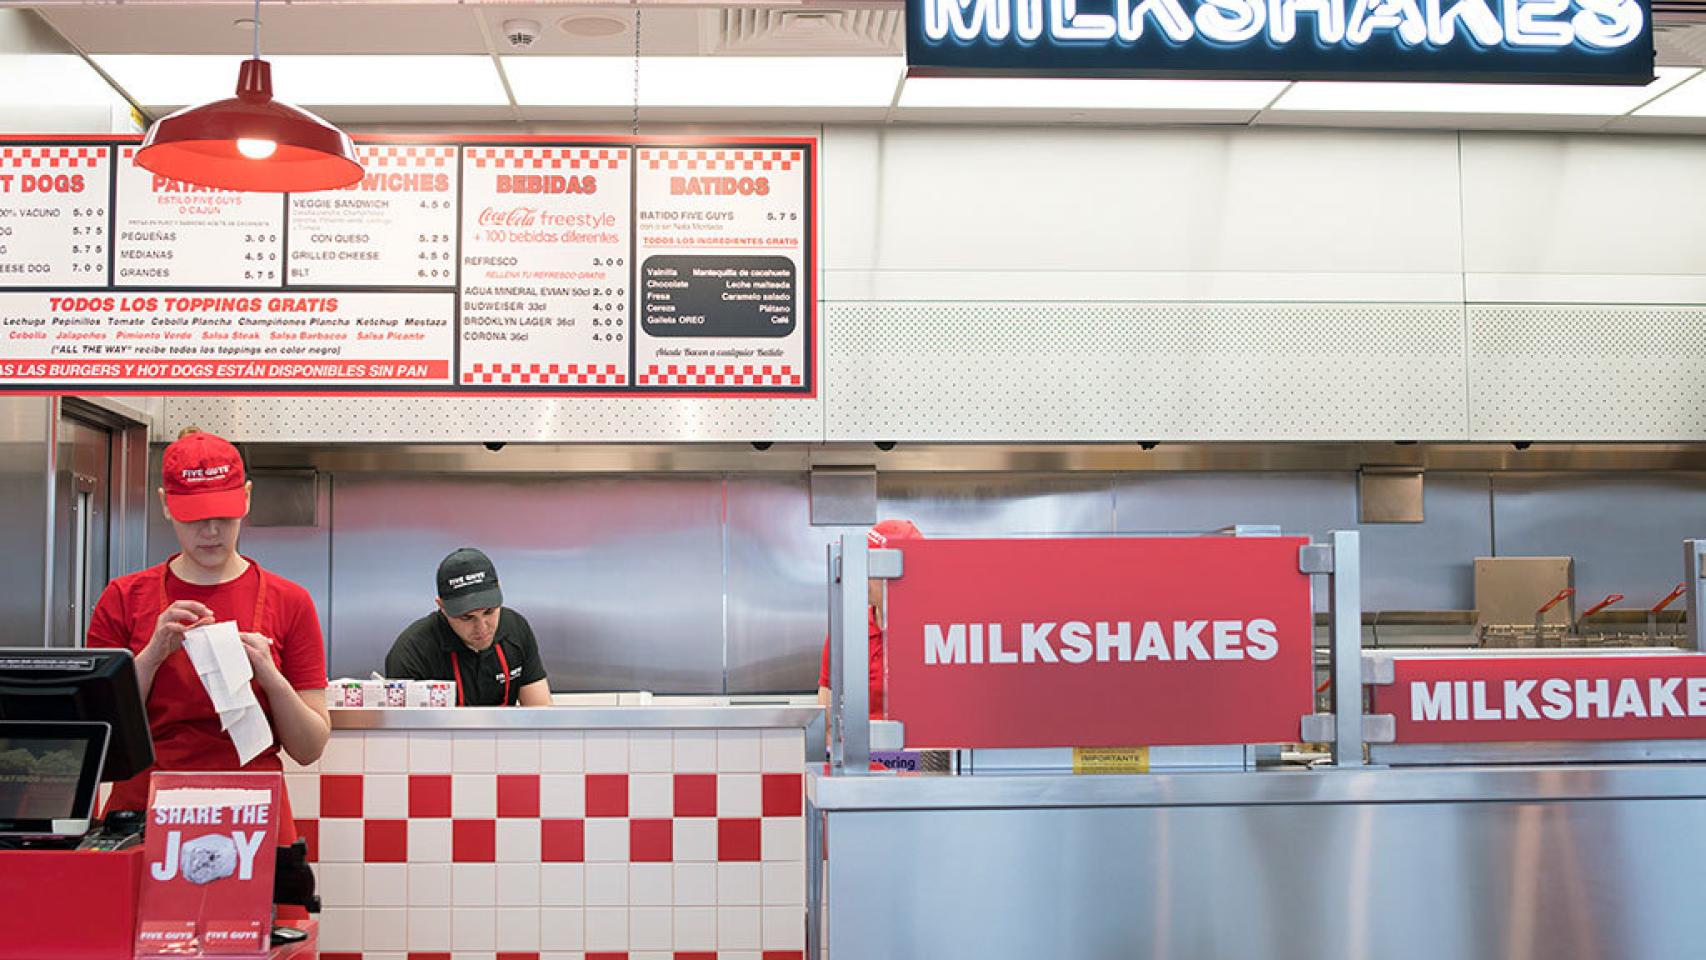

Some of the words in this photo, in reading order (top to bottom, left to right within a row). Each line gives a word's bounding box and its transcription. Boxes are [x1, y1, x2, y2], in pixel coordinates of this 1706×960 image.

[21, 174, 85, 193] DOGS
[342, 172, 449, 192] WICHES
[496, 174, 597, 194] BEBIDAS
[670, 176, 770, 196] BATIDOS
[292, 200, 331, 209] VEGGIE
[334, 200, 389, 209] SANDWICH
[20, 208, 61, 218] VACUNO
[640, 212, 678, 220] BATIDO
[681, 212, 703, 220] FIVE
[706, 212, 734, 220] GUYS
[540, 210, 616, 229] freestyle
[121, 230, 176, 241] PEQUEÑAS
[311, 235, 332, 243] CON
[334, 235, 370, 243] QUESO
[485, 230, 506, 242] 100
[509, 230, 558, 243] bebidas
[561, 230, 619, 244] diferentes
[643, 237, 674, 245] TODOS
[677, 237, 694, 245] LOS
[698, 237, 763, 245] INGREDIENTES
[766, 237, 798, 245] GRATIS
[120, 250, 174, 259] MEDIANAS
[292, 252, 335, 260] GRILLED
[338, 252, 380, 260] CHEESE
[464, 256, 518, 266] REFRESCO
[28, 264, 51, 273] DOG
[120, 268, 170, 277] GRANDES
[291, 268, 310, 277] BLT
[647, 268, 678, 276] Vainilla
[692, 268, 737, 278] Mantequilla
[751, 268, 791, 277] cacahuete
[647, 280, 688, 288] Chocolate
[726, 281, 751, 289] Leche
[753, 281, 791, 289] malteada
[464, 287, 492, 296] AGUA
[494, 287, 537, 296] MINERAL
[540, 287, 569, 296] EVIAN
[647, 292, 670, 300] Fresa
[722, 293, 761, 301] Caramelo
[763, 293, 790, 301] salado
[50, 298, 115, 312] TODOS
[120, 298, 158, 312] LOS
[165, 298, 262, 312] TOPPINGS
[268, 298, 338, 312] GRATIS
[464, 302, 524, 311] BUDWEISER
[647, 304, 675, 312] Cereza
[3, 318, 46, 326] Lechuga
[52, 318, 101, 326] Pepinillos
[108, 318, 145, 326] Tomate
[151, 318, 189, 326] Cebolla
[192, 318, 232, 326] Plancha
[238, 318, 306, 326] Champiñones
[310, 318, 350, 326] Plancha
[356, 318, 399, 326] Ketchup
[404, 318, 447, 326] Mostaza
[464, 317, 517, 326] BROOKLYN
[520, 317, 552, 326] LAGER
[647, 316, 676, 324] Galleta
[678, 316, 704, 324] OREO
[10, 332, 47, 340] Cebolla
[56, 332, 107, 340] Jalapeños
[116, 332, 161, 340] Pimiento
[164, 332, 192, 340] Verde
[202, 332, 229, 340] Salsa
[232, 332, 260, 340] Steak
[270, 332, 297, 340] Salsa
[300, 332, 347, 340] Barbacoa
[357, 332, 384, 340] Salsa
[387, 332, 425, 340] Picante
[464, 332, 507, 341] CORONA
[82, 345, 101, 355] THE
[134, 345, 166, 355] recibe
[170, 345, 197, 355] todos
[200, 345, 215, 355] los
[218, 345, 261, 355] toppings
[265, 345, 277, 355] en
[280, 345, 306, 355] color
[308, 345, 341, 355] negro)
[16, 364, 46, 376] LAS
[49, 364, 120, 376] BURGERS
[124, 364, 135, 376] Y
[137, 364, 169, 376] HOT
[171, 364, 213, 376] DOGS
[216, 362, 265, 376] ESTÁN
[268, 364, 366, 376] DISPONIBLES
[368, 364, 394, 376] SIN
[396, 364, 429, 376] PAN
[924, 618, 1279, 665] MILKSHAKES
[1410, 677, 1706, 720] MILKSHAKE
[155, 805, 222, 825] SHARE
[231, 804, 269, 825] THE
[140, 932, 162, 940] FIVE
[165, 932, 193, 940] GUYS
[206, 932, 228, 941] FIVE
